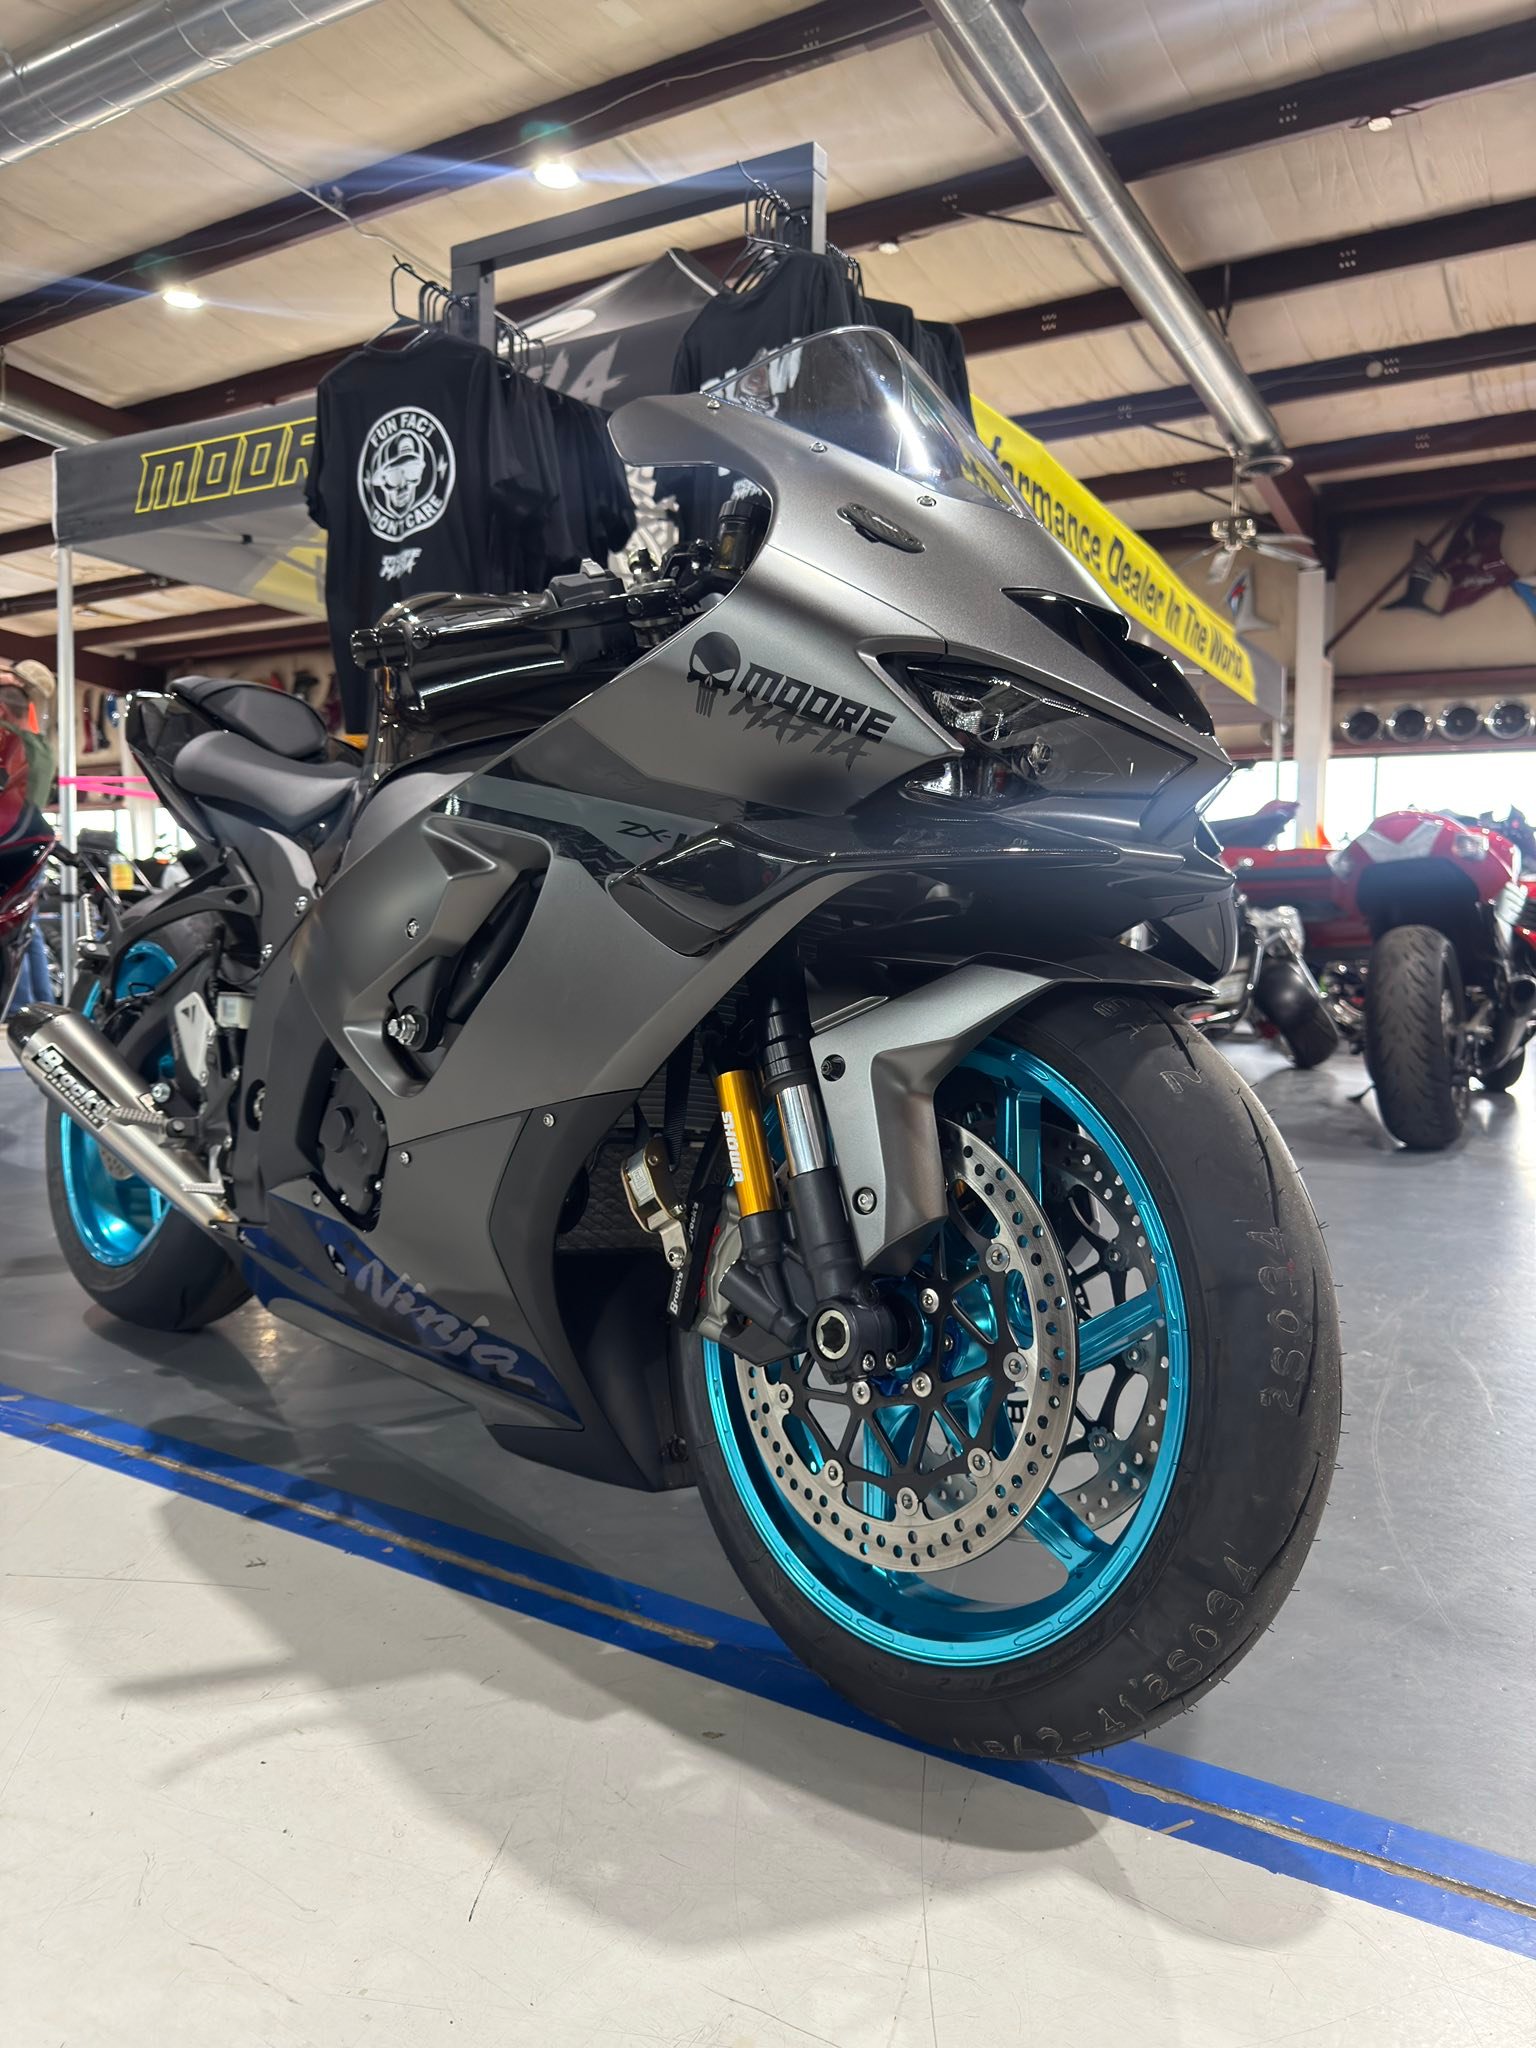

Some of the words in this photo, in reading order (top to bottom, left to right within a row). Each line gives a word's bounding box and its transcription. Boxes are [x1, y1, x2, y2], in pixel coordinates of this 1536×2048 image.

[369, 417, 398, 448] FUN
[399, 413, 437, 438] FACT
[405, 494, 443, 529] CARE
[1108, 536, 1165, 621] Dealer
[1165, 587, 1182, 637] In
[1184, 601, 1207, 654] The
[1208, 627, 1243, 680] World
[728, 691, 872, 777] MAFIA
[737, 662, 897, 744] MOORE
[721, 1111, 745, 1183] SHOWA
[354, 1258, 536, 1388] Ninja
[669, 1271, 684, 1316] Brock's
